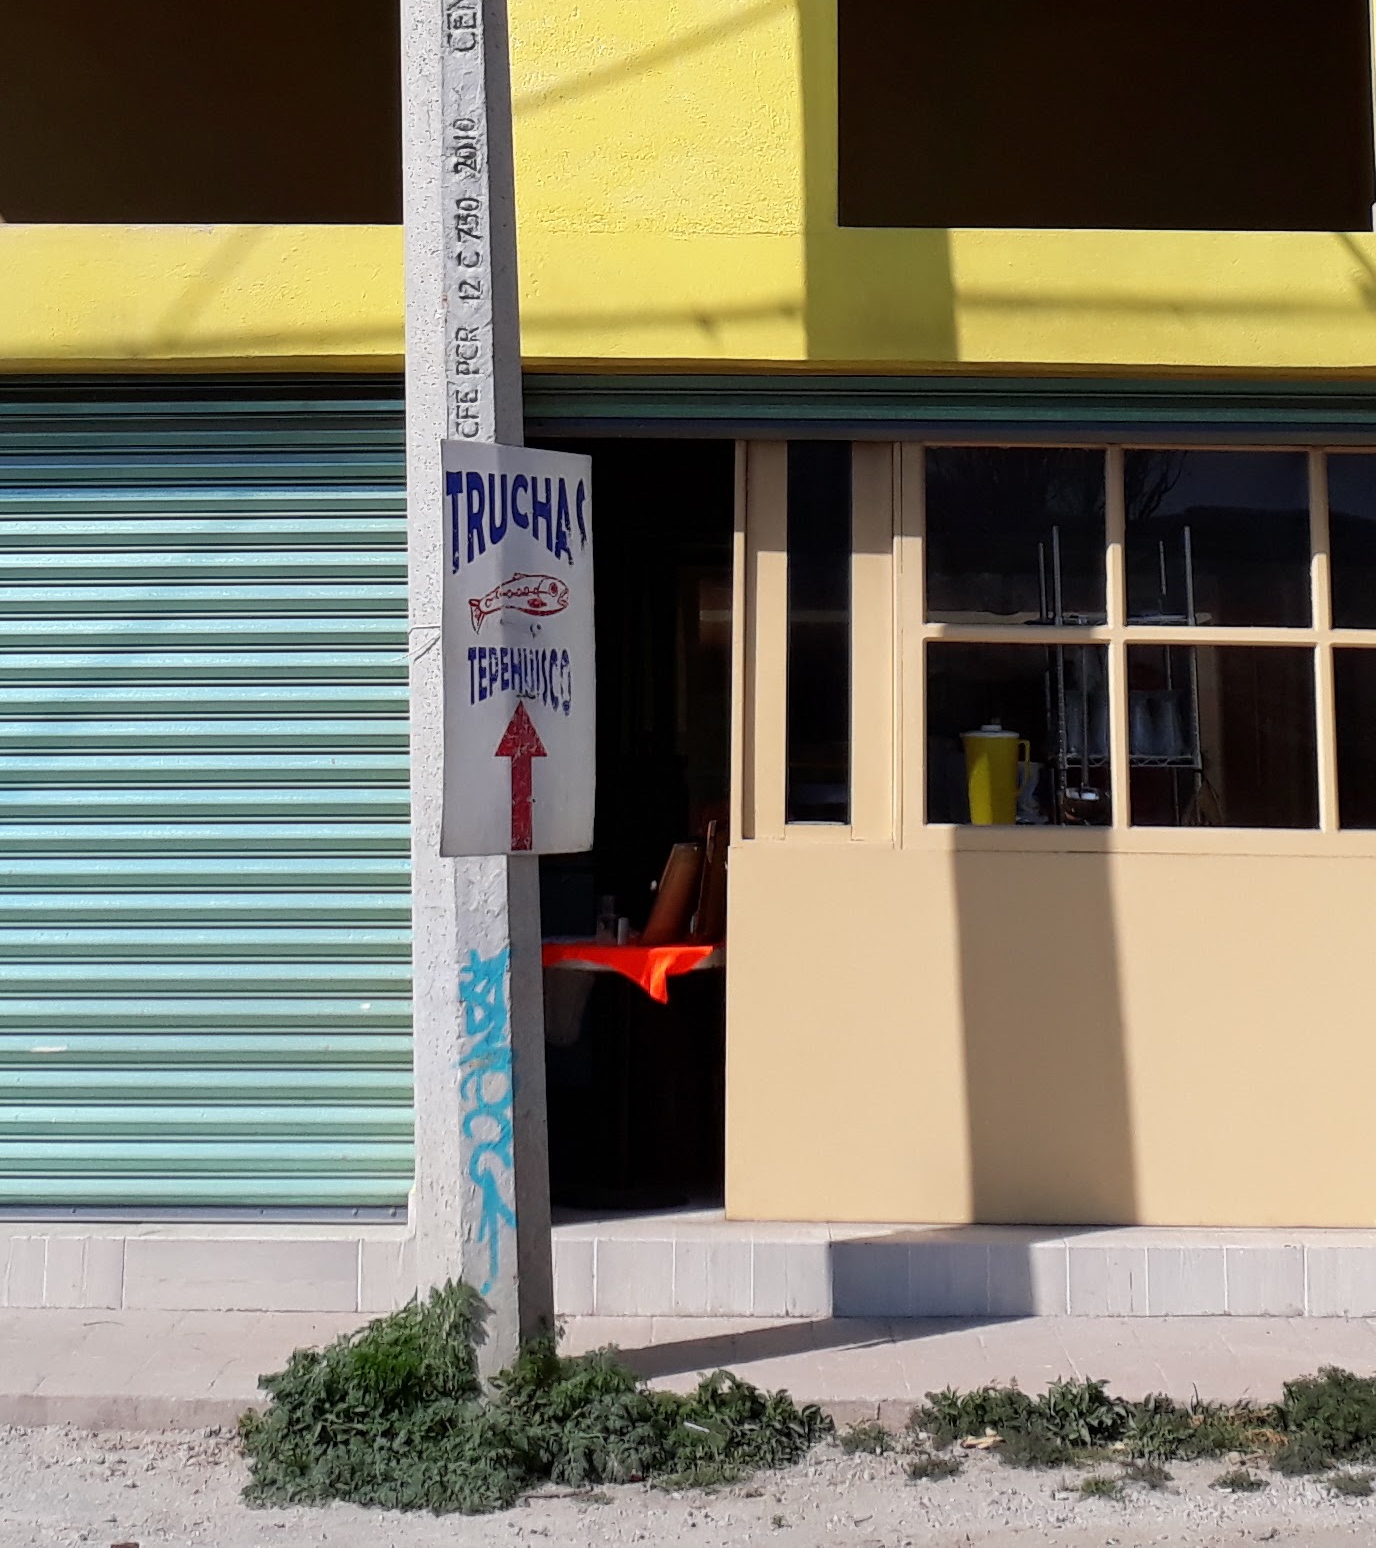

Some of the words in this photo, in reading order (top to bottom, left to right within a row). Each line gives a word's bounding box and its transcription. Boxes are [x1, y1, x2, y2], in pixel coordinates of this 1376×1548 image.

[454, 325, 481, 376] PCR
[454, 387, 480, 439] CFE
[446, 470, 588, 574] TRUCHAS
